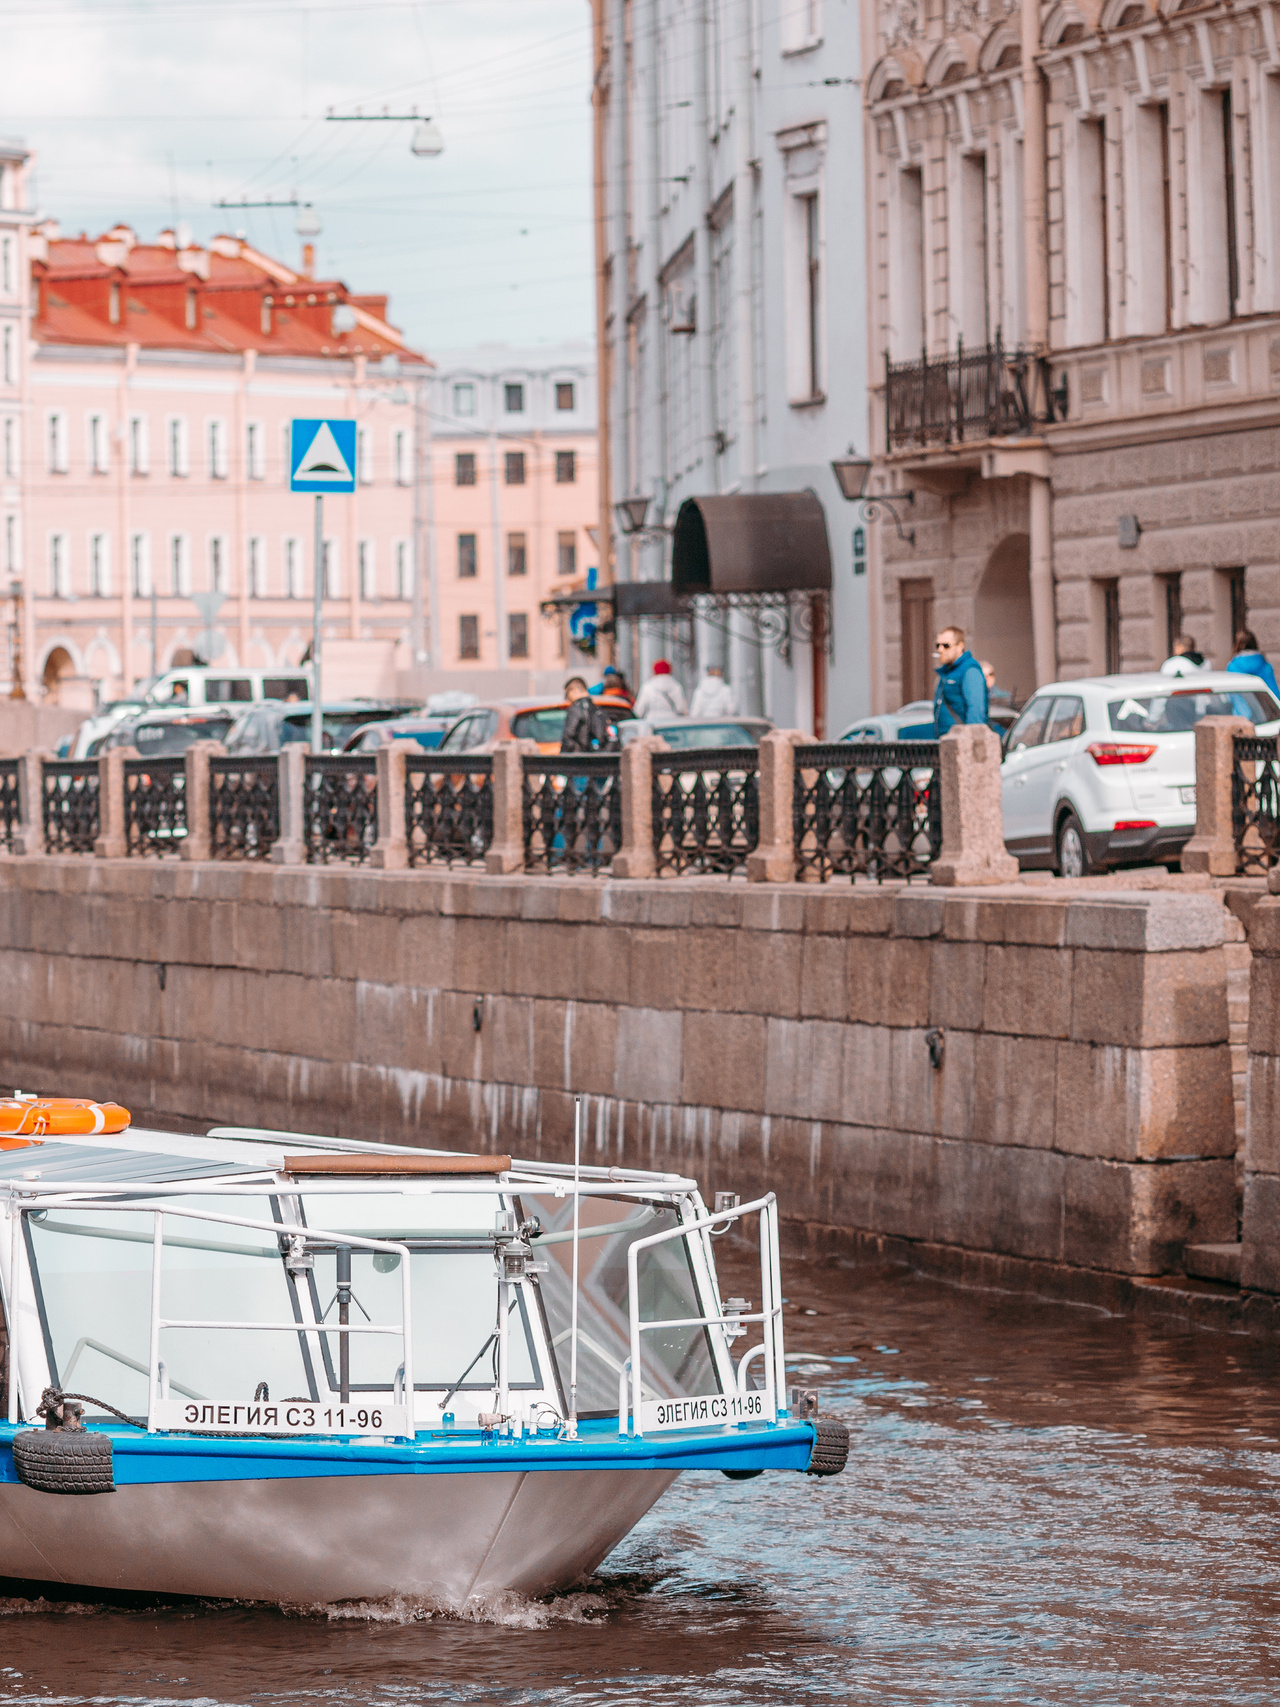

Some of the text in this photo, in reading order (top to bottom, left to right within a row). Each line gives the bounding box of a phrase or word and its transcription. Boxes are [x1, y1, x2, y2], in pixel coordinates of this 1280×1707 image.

[184, 1404, 278, 1426] ЭЛЕГИЯ
[323, 1408, 383, 1428] 11-96
[657, 1400, 708, 1424] ЭЛЕГИЯ
[731, 1396, 762, 1416] 11-96
